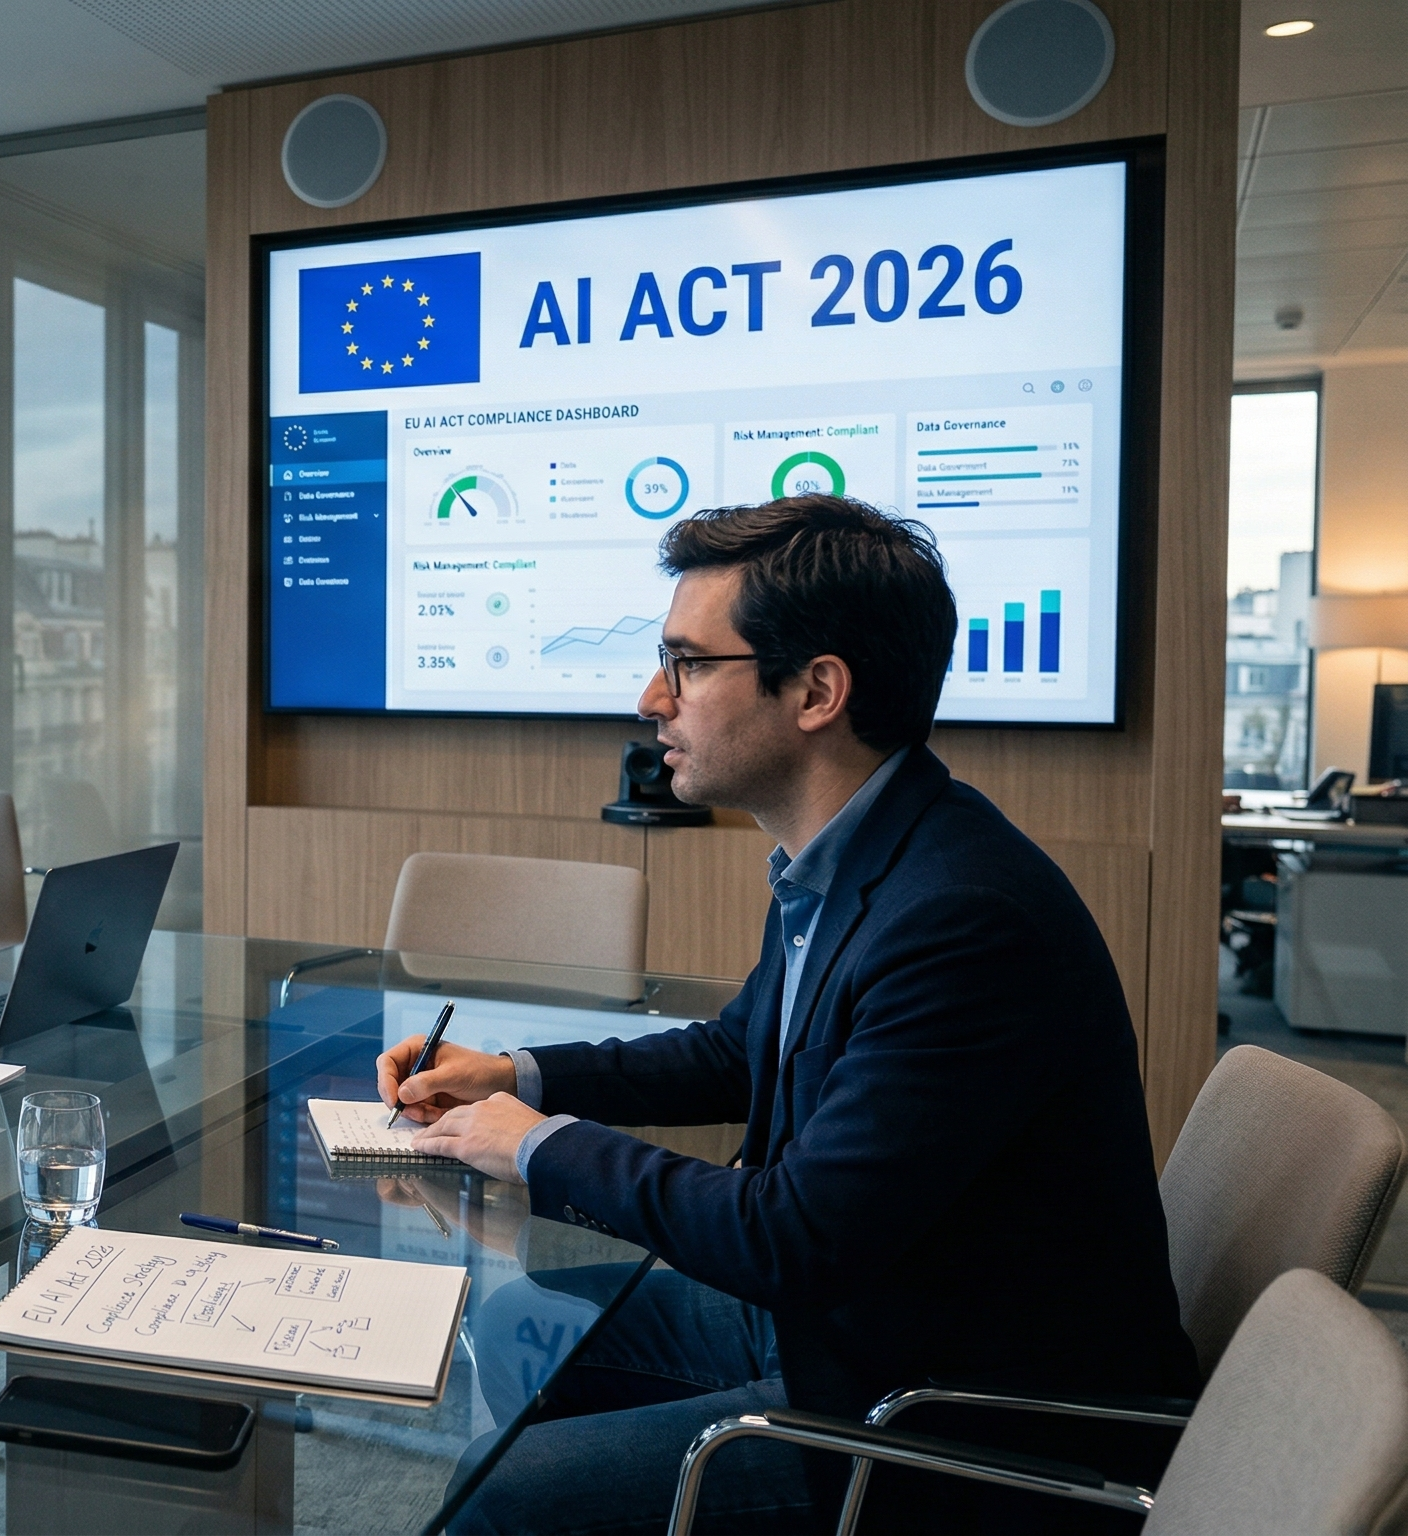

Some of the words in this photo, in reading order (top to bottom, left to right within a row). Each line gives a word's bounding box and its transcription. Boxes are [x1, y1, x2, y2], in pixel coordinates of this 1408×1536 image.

[519, 276, 591, 349] AI
[619, 260, 782, 341] ACT
[810, 238, 1023, 328] 2026
[405, 417, 421, 430] EU
[423, 416, 436, 429] AI
[439, 414, 465, 428] ACT
[467, 409, 553, 426] COMPLIANCE
[556, 404, 640, 421] DASHBOARD
[916, 421, 941, 432] Data
[943, 417, 1007, 431] Governance
[733, 429, 755, 441] Risk
[757, 427, 824, 441] Management:
[826, 424, 879, 438] Compliant
[413, 446, 452, 457] Overview
[644, 483, 668, 495] 39%
[418, 655, 456, 669] 3.35%
[21, 1303, 58, 1324] EU
